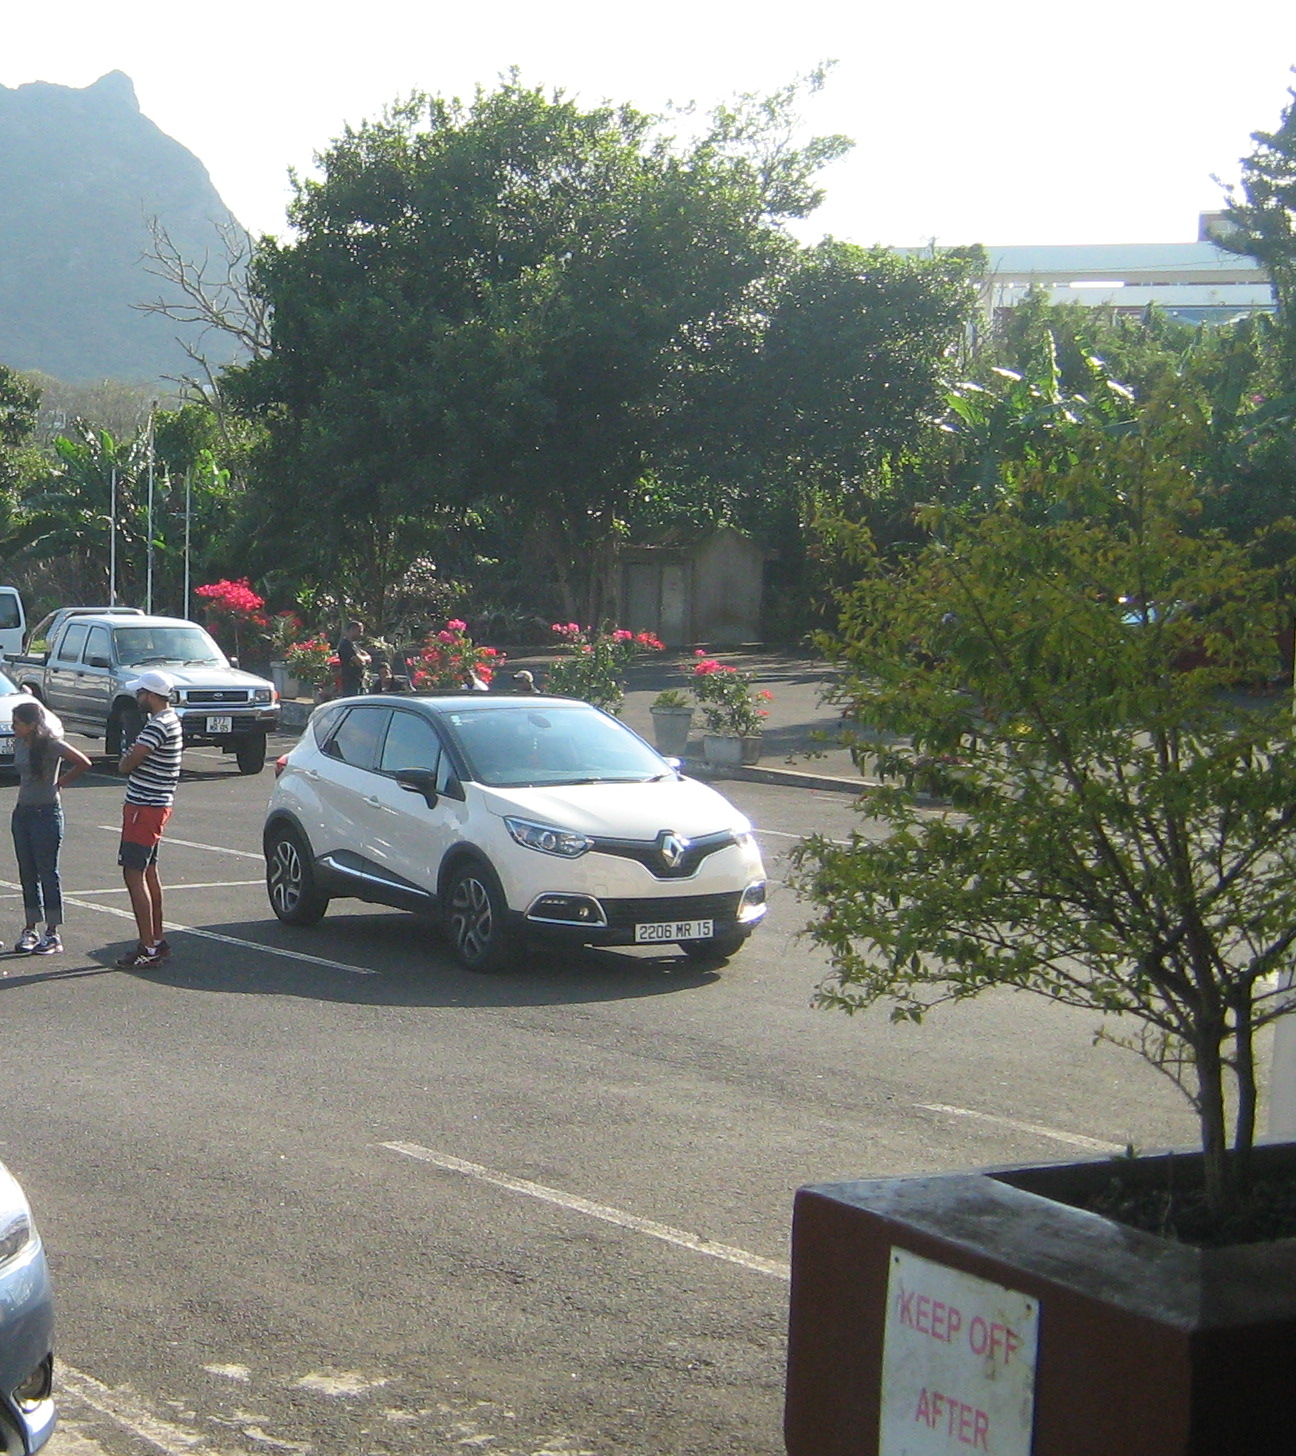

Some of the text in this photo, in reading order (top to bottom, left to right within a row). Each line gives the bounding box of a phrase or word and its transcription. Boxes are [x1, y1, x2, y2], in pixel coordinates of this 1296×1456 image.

[639, 921, 711, 940] 2206 MR 15
[898, 1287, 1023, 1364] KEEP OFF
[914, 1386, 990, 1453] AFTER
